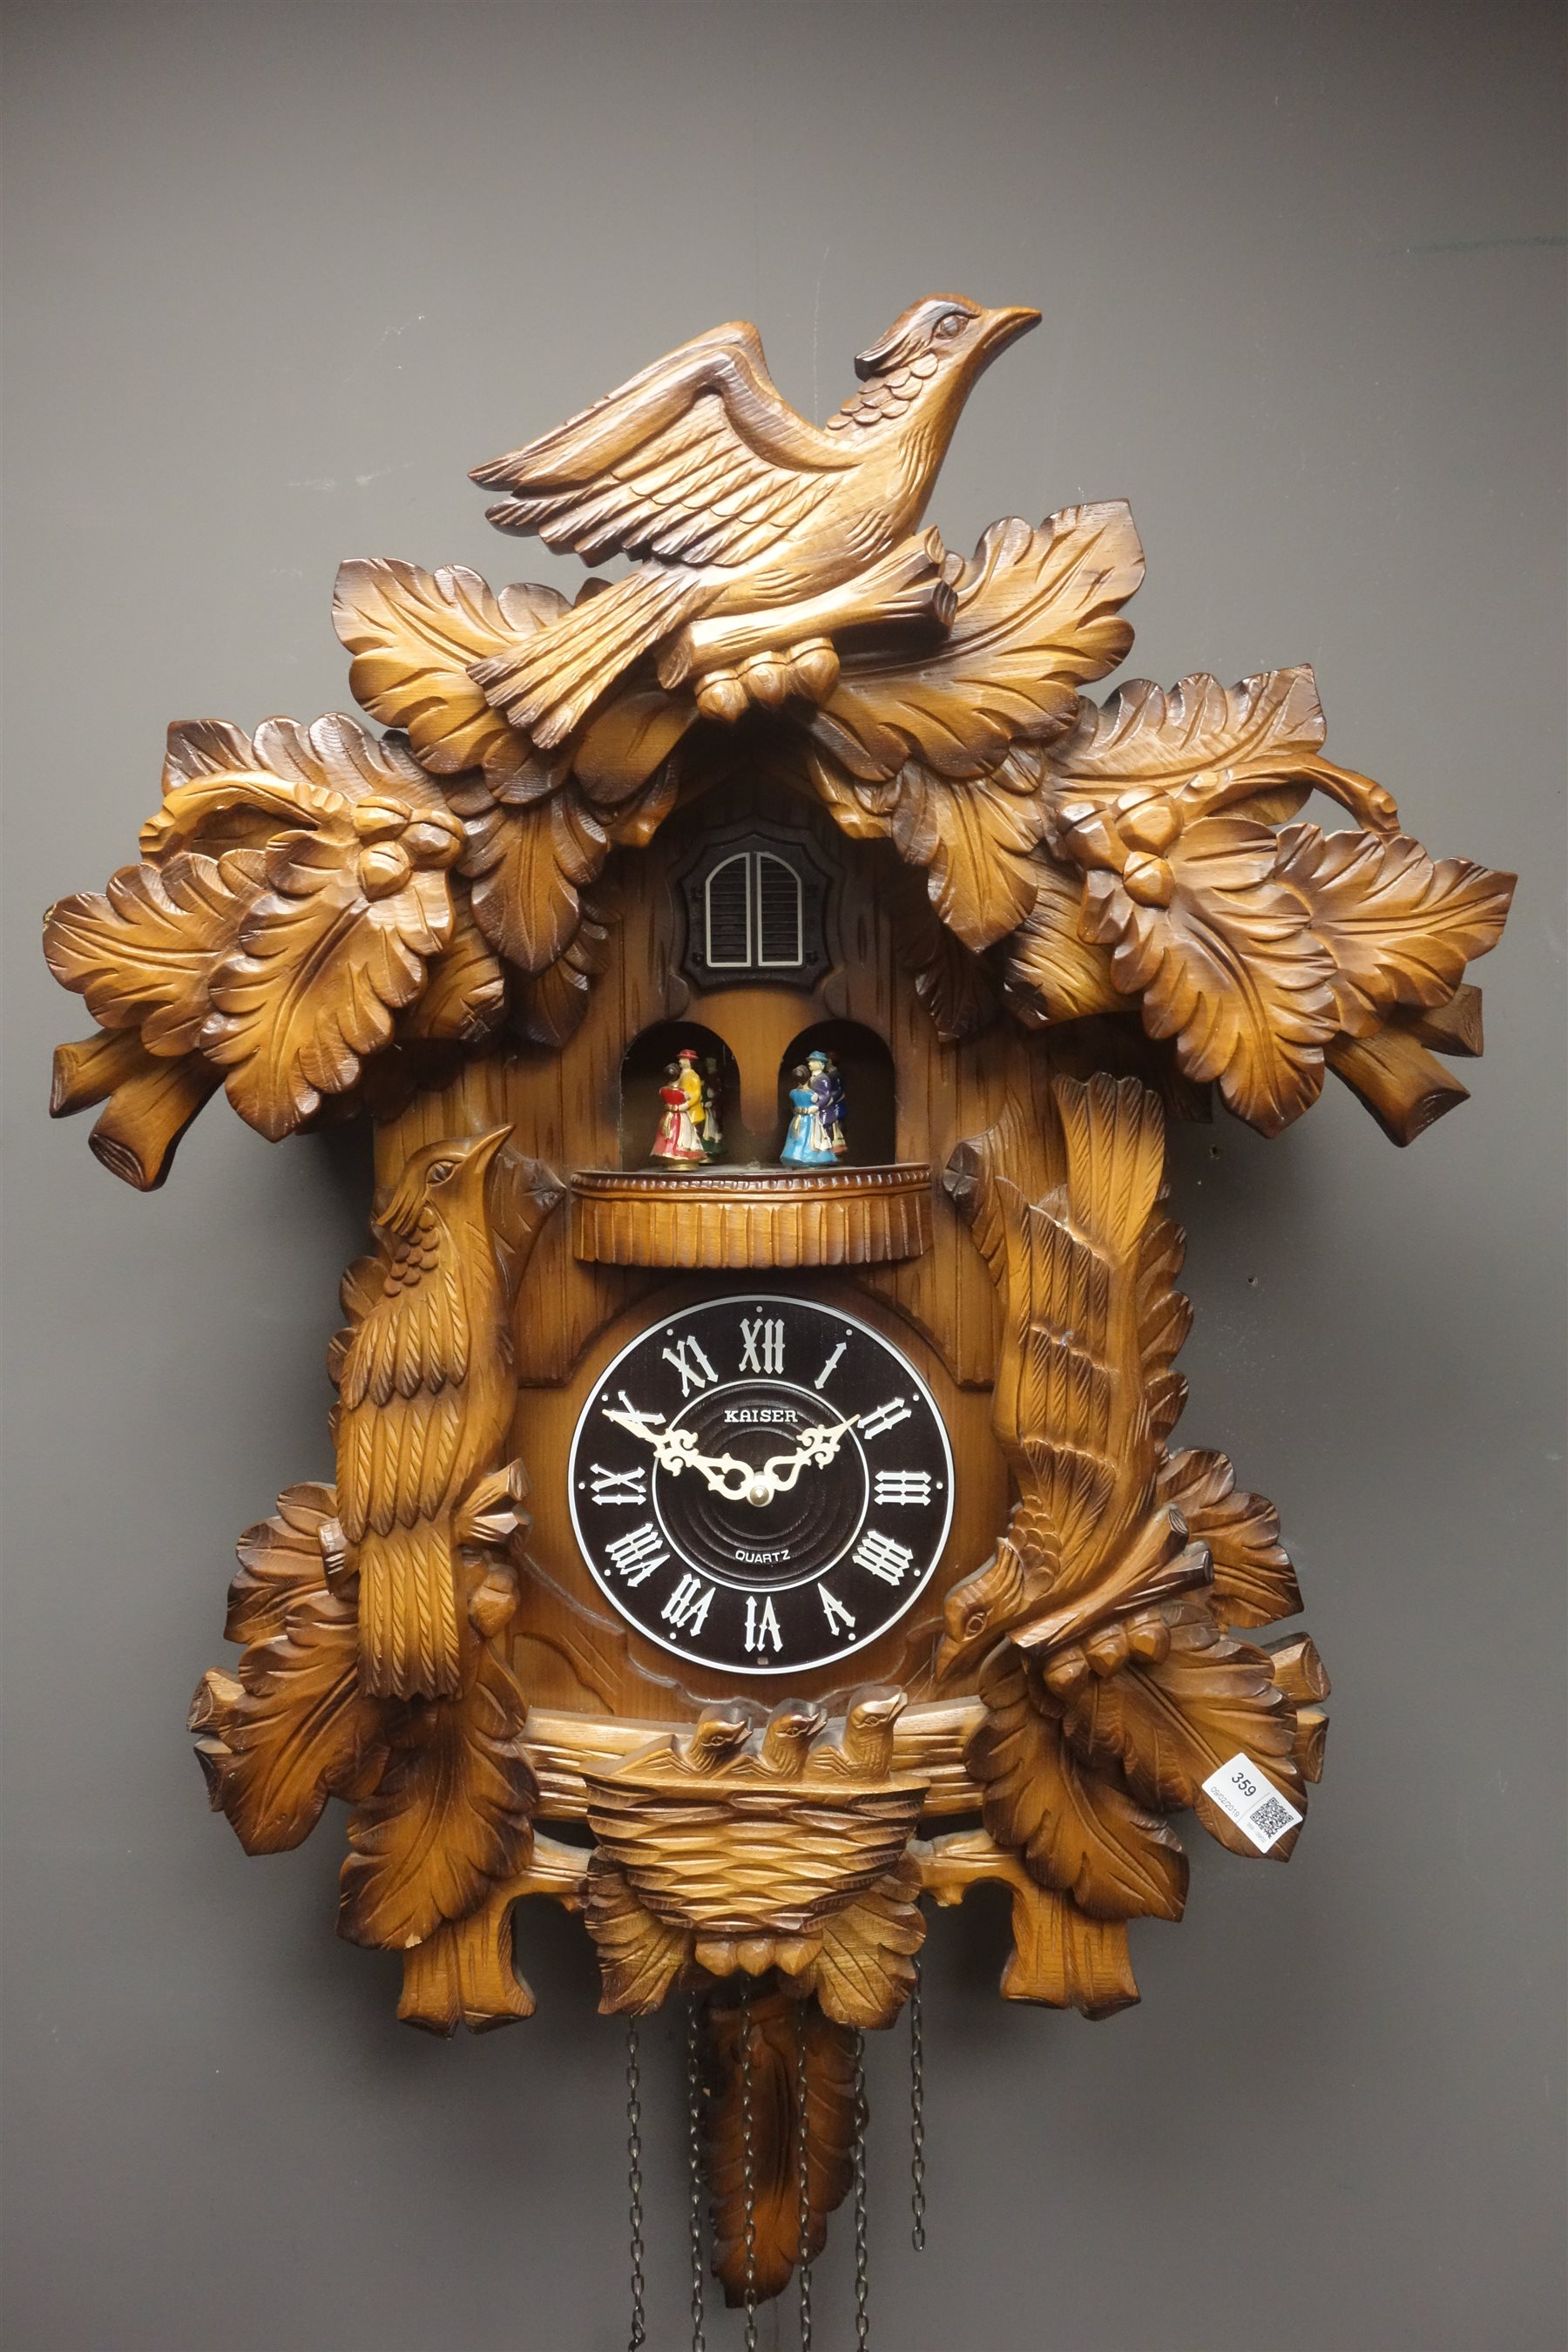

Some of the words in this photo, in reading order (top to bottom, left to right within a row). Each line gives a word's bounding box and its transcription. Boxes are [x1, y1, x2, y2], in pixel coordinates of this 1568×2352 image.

[662, 1335, 719, 1397] XI
[739, 1318, 786, 1375] XII
[814, 1342, 848, 1389] I
[724, 1409, 799, 1423] KAISER
[856, 1396, 912, 1440] II
[590, 1463, 647, 1506] IX
[874, 1470, 932, 1506] III
[605, 1523, 671, 1588] VIII
[735, 1549, 791, 1564] QUARTZ
[852, 1530, 915, 1586] IIII
[661, 1573, 717, 1637] VII
[744, 1595, 783, 1652] VI
[817, 1582, 856, 1636] V
[1231, 1772, 1257, 1796] 359
